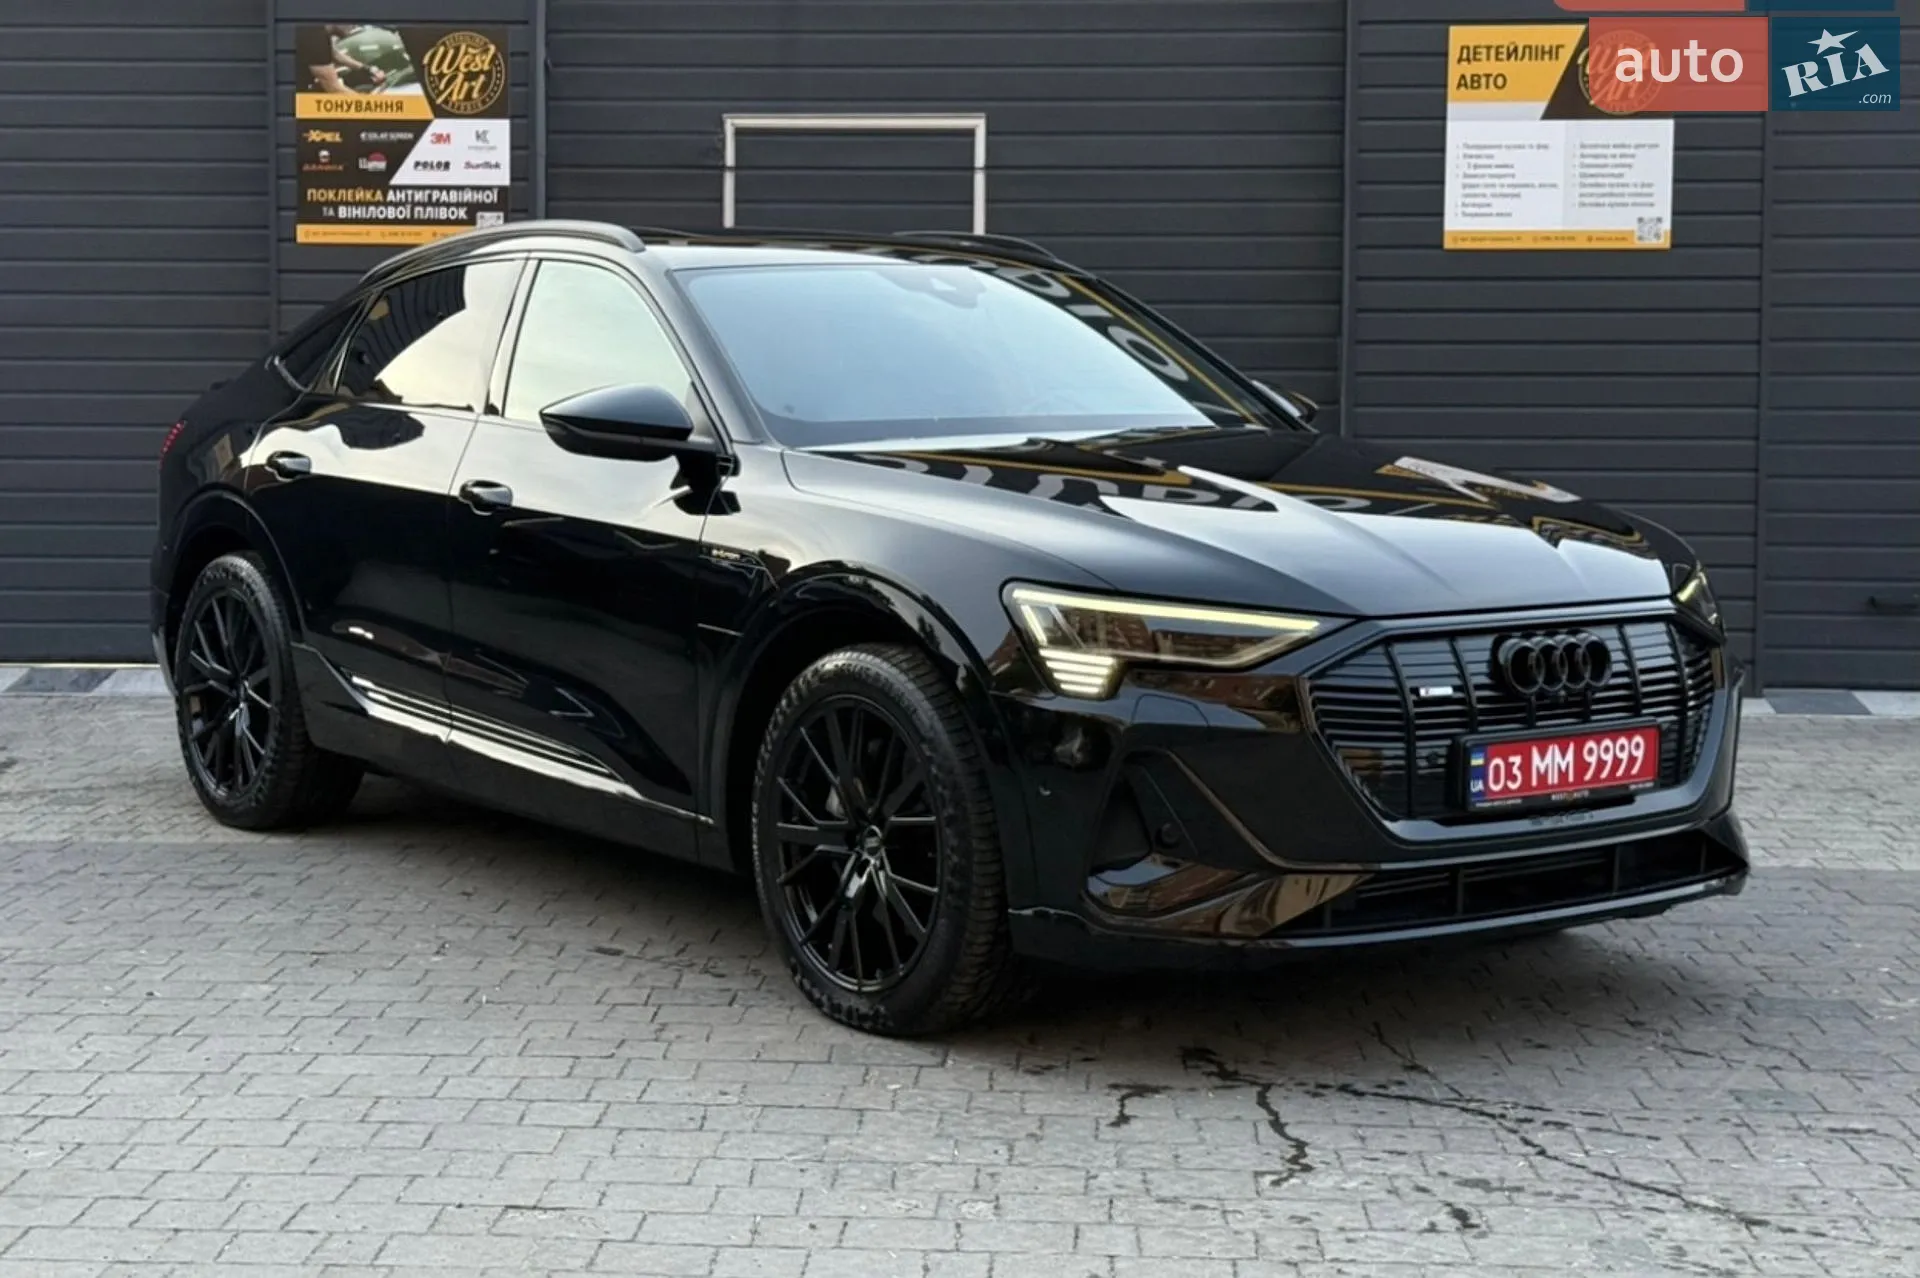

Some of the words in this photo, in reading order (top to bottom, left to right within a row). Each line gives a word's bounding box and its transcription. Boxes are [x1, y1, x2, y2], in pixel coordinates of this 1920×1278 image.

[422, 43, 497, 76] West
[1456, 42, 1565, 64] ДЕТЕЙЛІНГ
[435, 71, 486, 105] Art
[1456, 73, 1508, 91] АВТО
[315, 99, 405, 113] ТОНУВАННЯ
[430, 132, 451, 145] 3M
[306, 187, 384, 202] ПОКЛЕЙКА
[386, 188, 499, 203] АНТИГРАВІЙНОЇ
[322, 206, 336, 217] ТА
[338, 206, 411, 219] ВІНІЛОВОЇ
[414, 207, 469, 220] ПЛІВОК
[1488, 754, 1523, 792] 03
[1530, 741, 1575, 788] MM
[1582, 734, 1646, 782] 9999
[1470, 778, 1484, 793] UA
